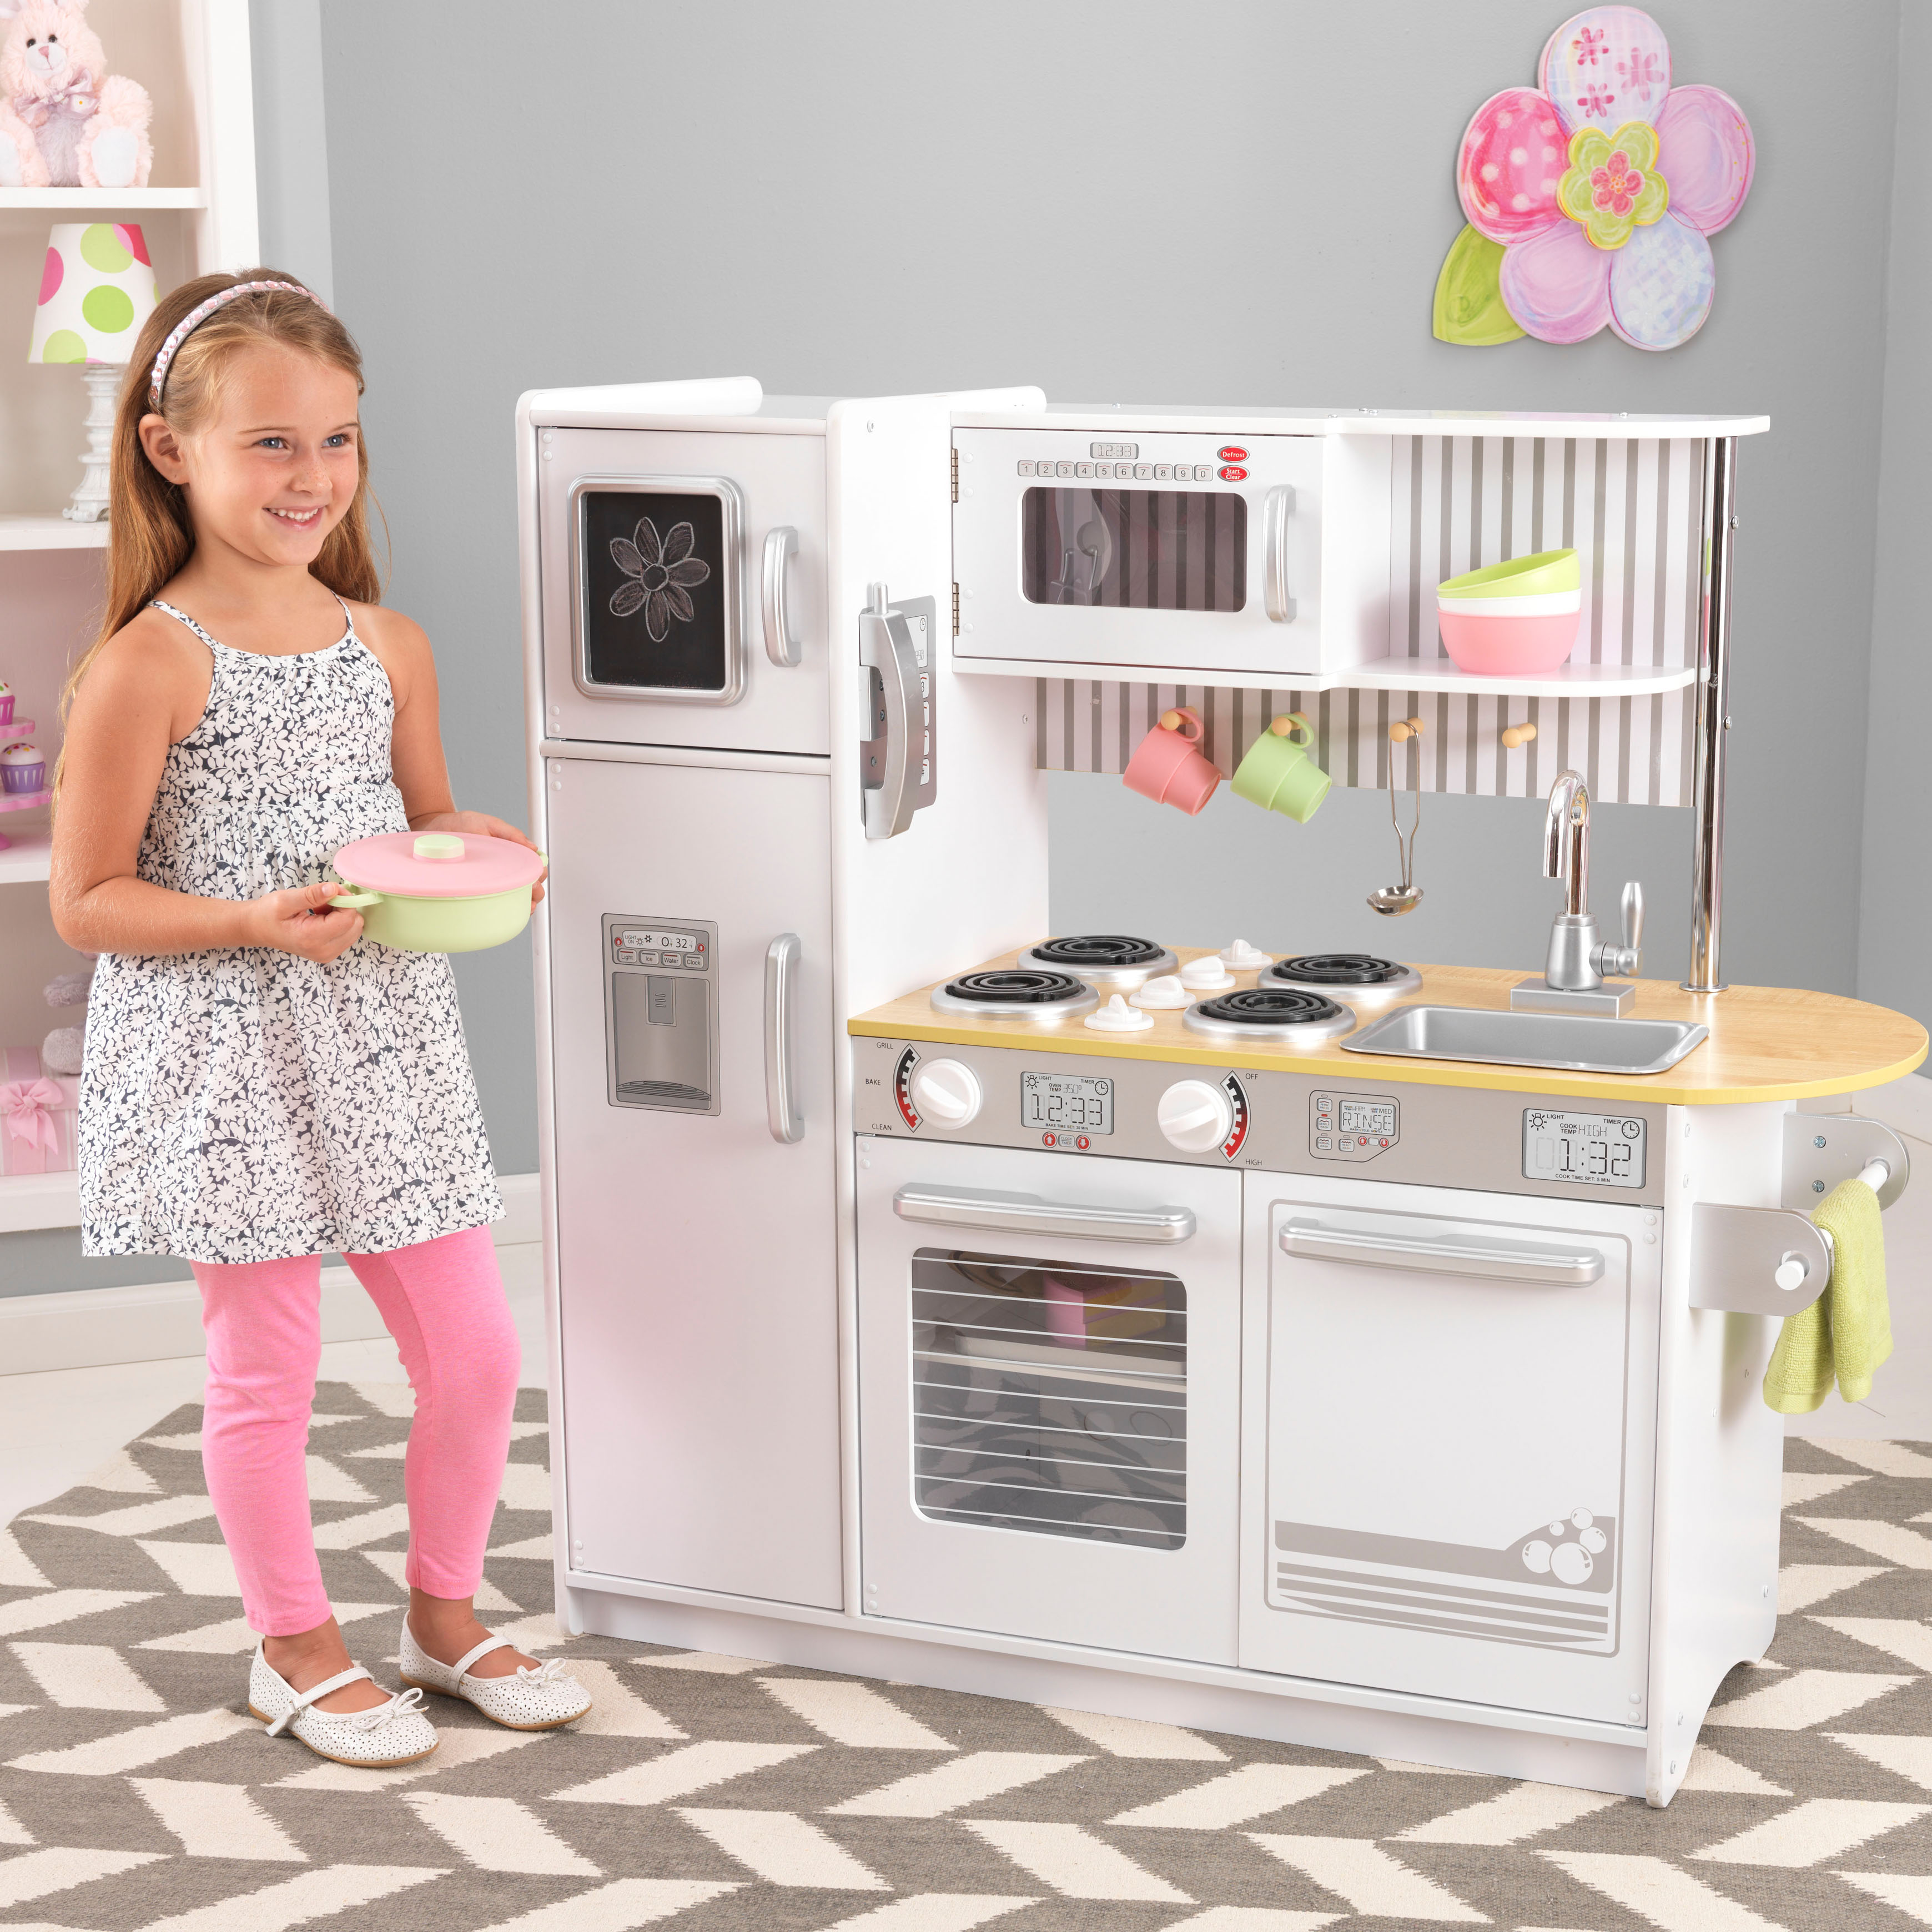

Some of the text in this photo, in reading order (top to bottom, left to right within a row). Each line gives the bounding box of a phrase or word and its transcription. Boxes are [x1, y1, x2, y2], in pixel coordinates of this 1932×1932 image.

[1099, 445, 1131, 457] 12:33
[676, 938, 687, 948] 32
[1032, 1094, 1103, 1126] 12:33
[1343, 1112, 1391, 1131] RINSE
[1578, 1124, 1607, 1137] HIGH
[1560, 1138, 1631, 1176] 1:32
